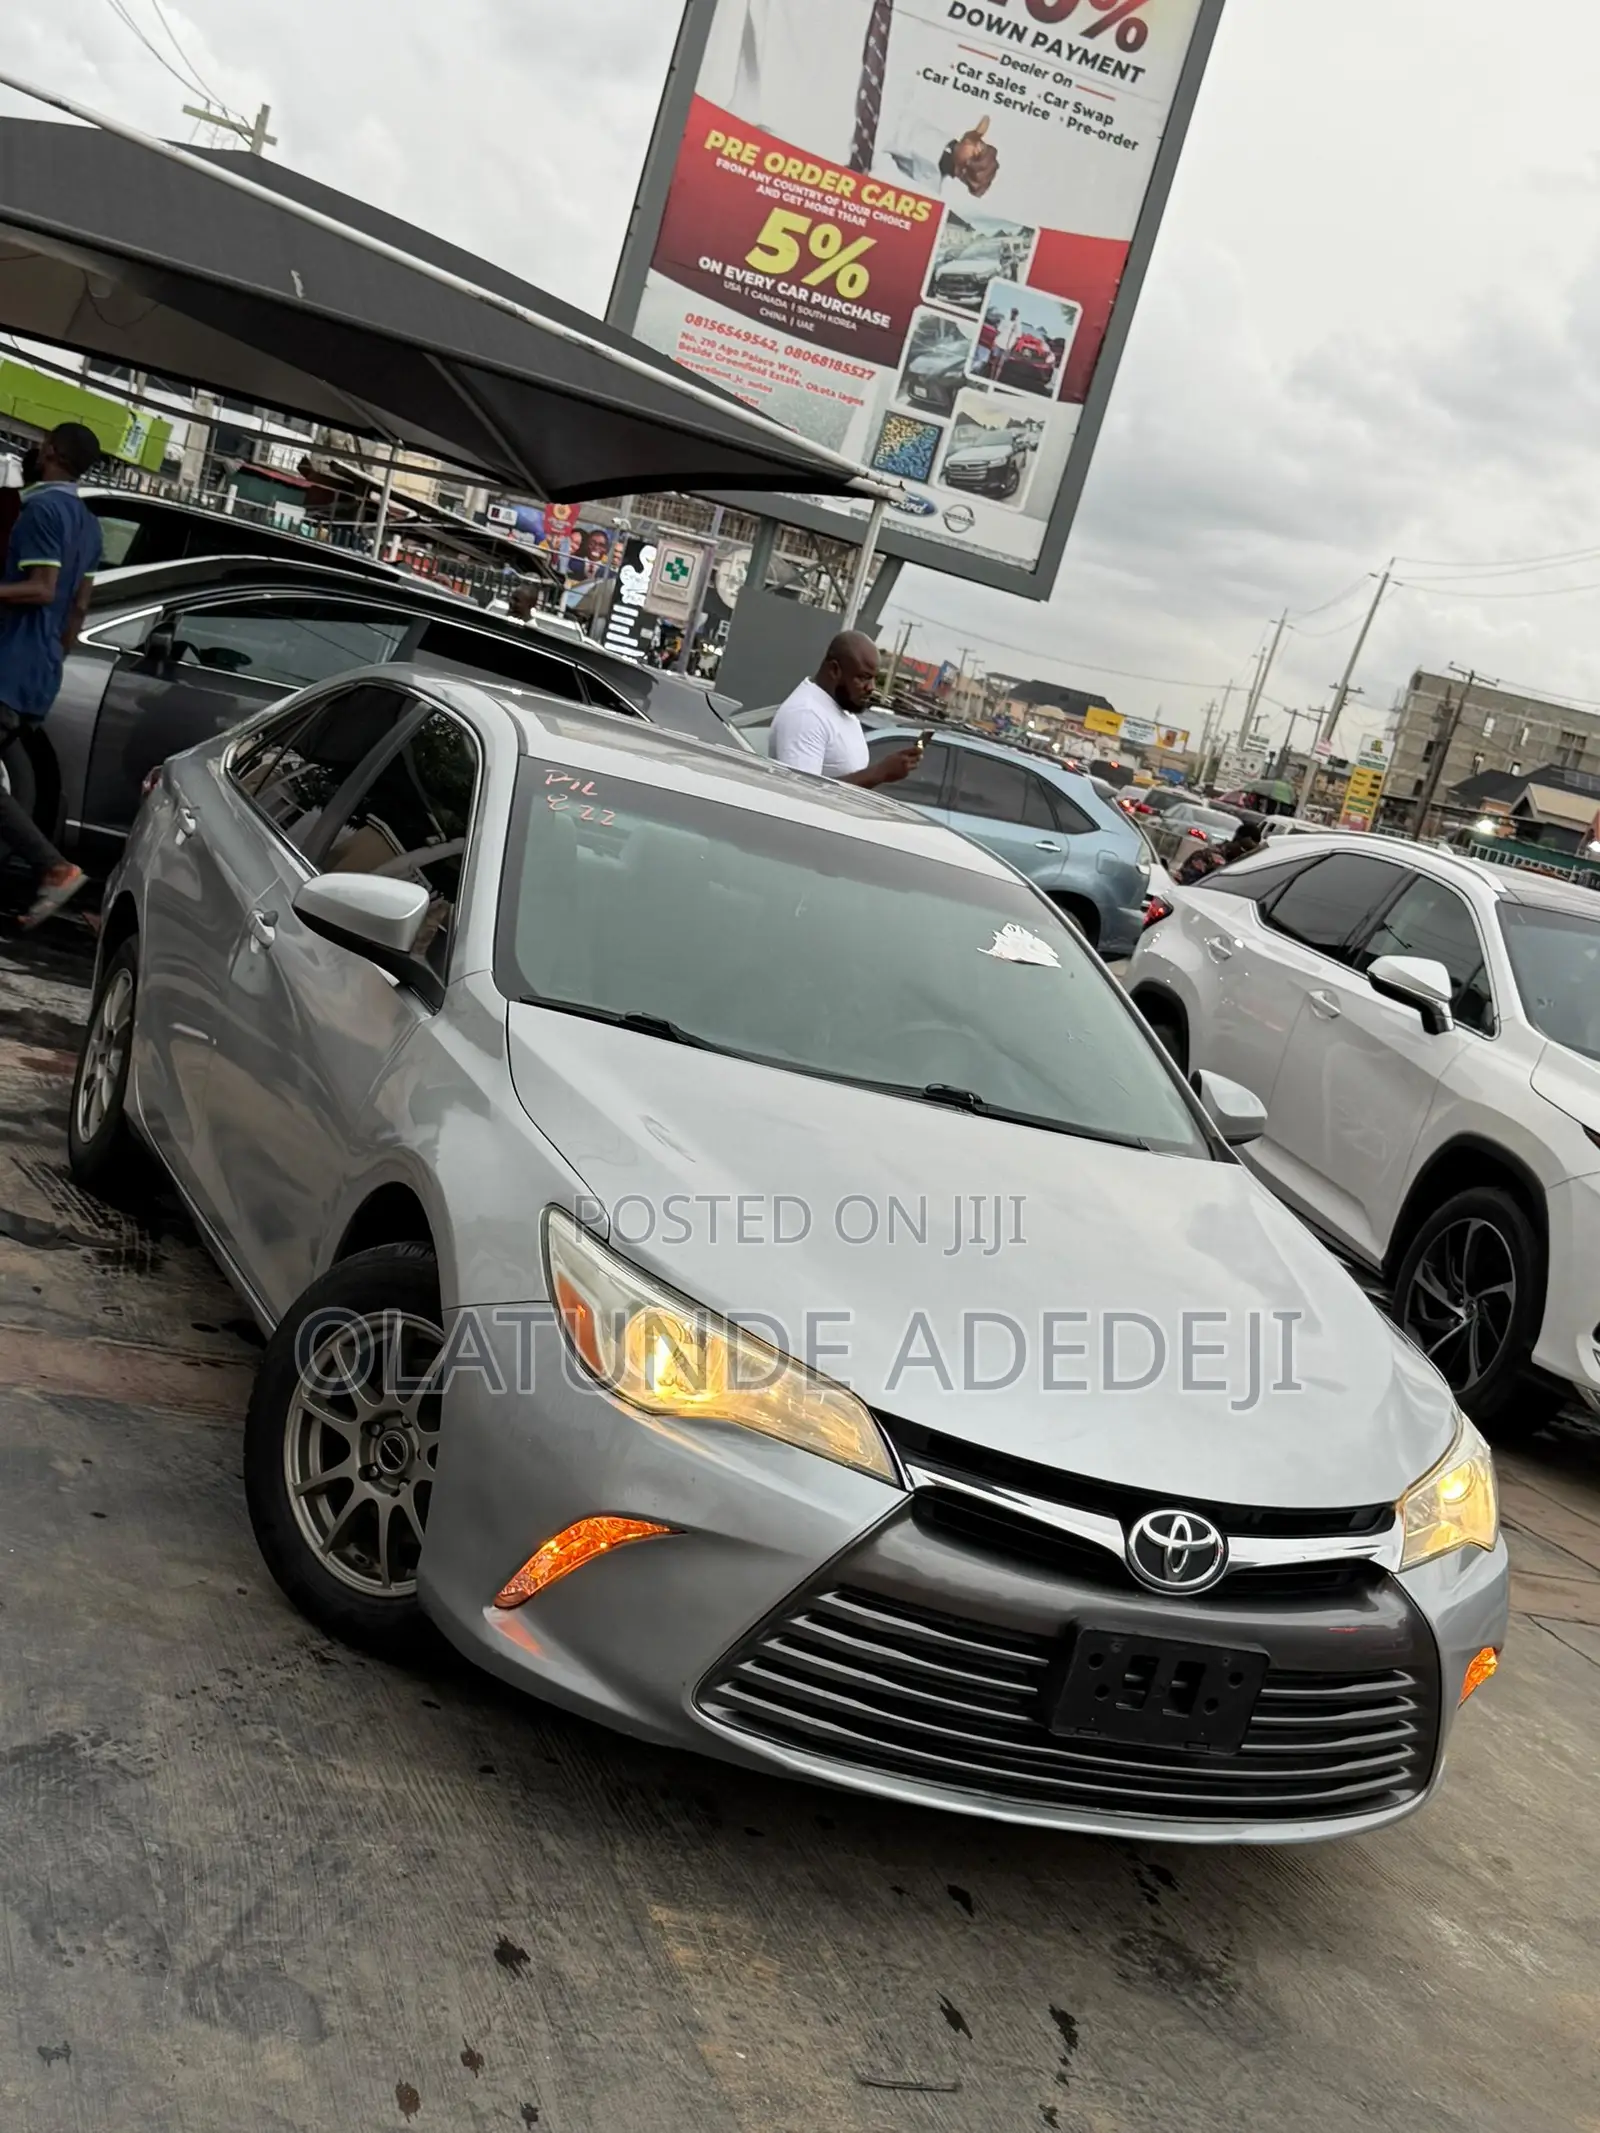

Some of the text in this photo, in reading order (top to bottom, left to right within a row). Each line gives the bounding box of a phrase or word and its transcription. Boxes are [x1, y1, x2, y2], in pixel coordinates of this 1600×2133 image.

[948, 2, 1028, 43] DOWN
[1031, 32, 1146, 84] PAYMENT
[1000, 54, 1073, 88] Dealer On
[922, 68, 1139, 151] Car Loan Service Pre-order
[957, 62, 1113, 126] Car Sales Car Swap
[704, 130, 932, 222] PRE ORDER CARS
[716, 158, 911, 230] FROM ANY COUNTRY OF YOUR CHOICE
[757, 184, 867, 227] AND GET MORE THAN
[745, 207, 877, 299] 5%
[699, 256, 891, 328] ON EVERY CAR PURCHASE
[724, 281, 741, 293] USA
[751, 291, 788, 309] CANADA
[797, 306, 826, 321] SOUTH
[828, 315, 857, 330] KOREA
[760, 308, 787, 323] CHINA
[797, 319, 814, 331] UAE
[678, 342, 712, 359] Beside
[715, 353, 767, 376] Greenfield
[741, 351, 774, 367] Palace
[784, 345, 876, 380] 08068185527
